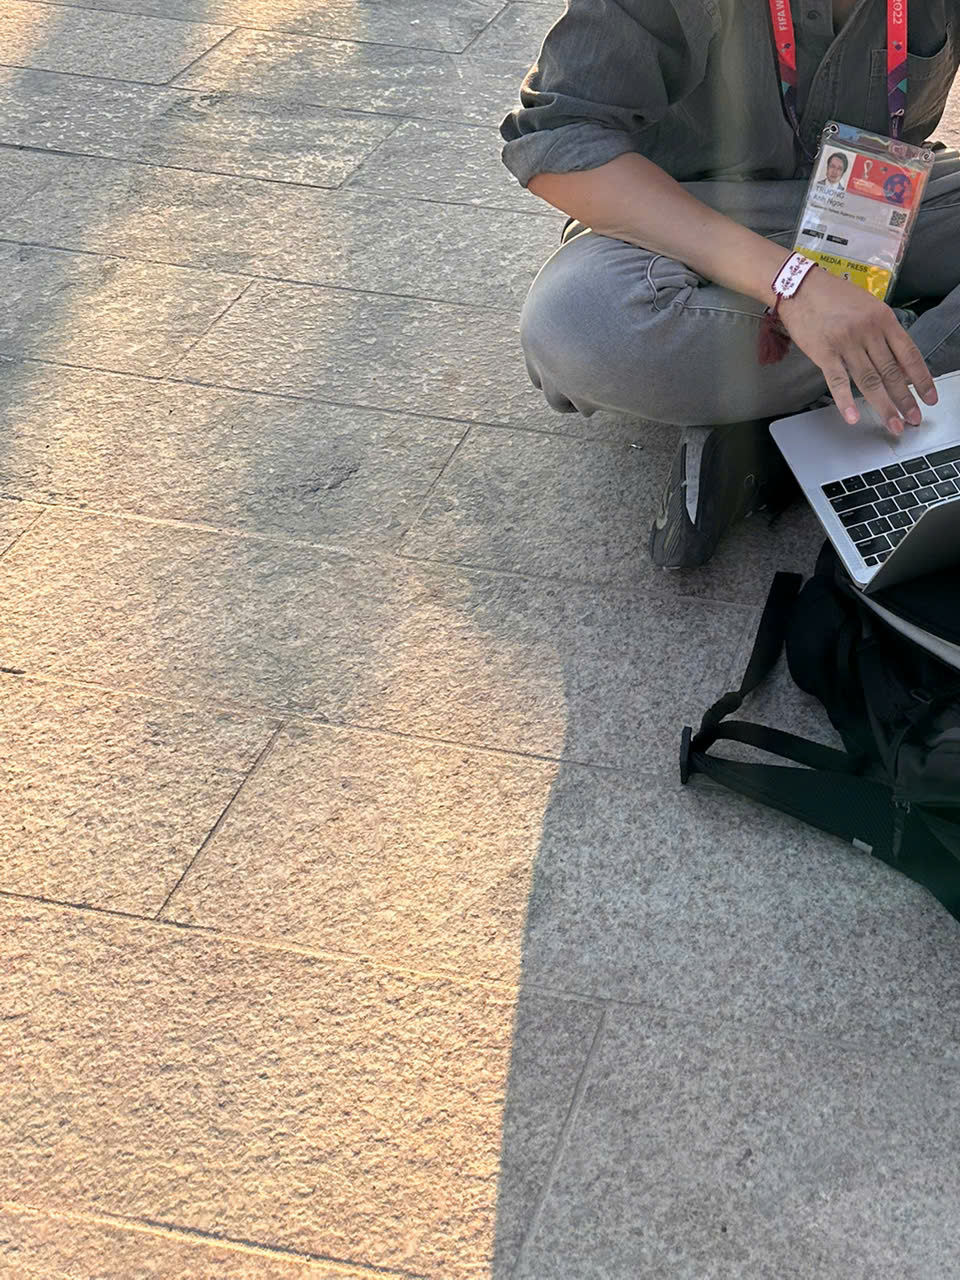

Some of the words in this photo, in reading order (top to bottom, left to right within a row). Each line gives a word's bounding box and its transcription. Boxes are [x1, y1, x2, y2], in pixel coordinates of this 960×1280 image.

[777, 9, 788, 31] FIFA
[820, 254, 842, 266] MEDIA
[846, 261, 868, 273] PRESS
